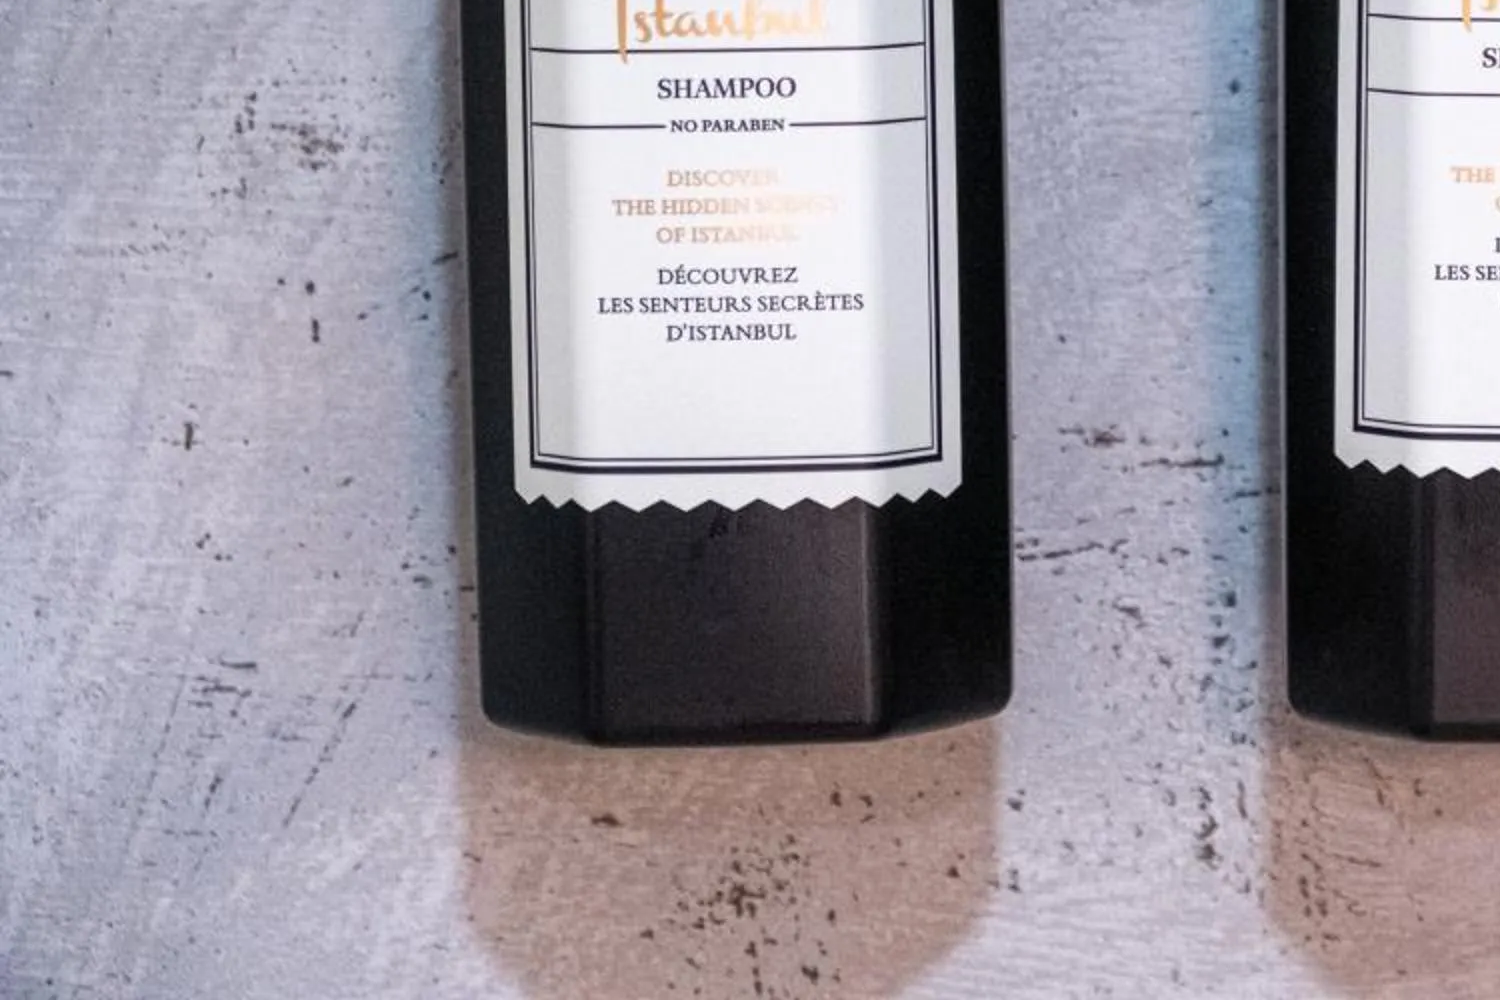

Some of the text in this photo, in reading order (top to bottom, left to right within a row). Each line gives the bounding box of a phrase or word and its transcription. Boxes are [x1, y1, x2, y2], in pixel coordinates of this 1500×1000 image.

[658, 77, 796, 99] SHAMPOO
[671, 119, 784, 132] NO PARABEN
[1451, 166, 1494, 184] THE
[612, 199, 656, 216] THE
[662, 198, 752, 216] HIDDEN
[656, 227, 686, 244] OF
[658, 264, 798, 285] DÉCOUVREZ
[1435, 265, 1470, 280] LES
[598, 291, 864, 314] LES SENTEURS SECRÈTES
[667, 323, 796, 342] D'ISTANBUL
